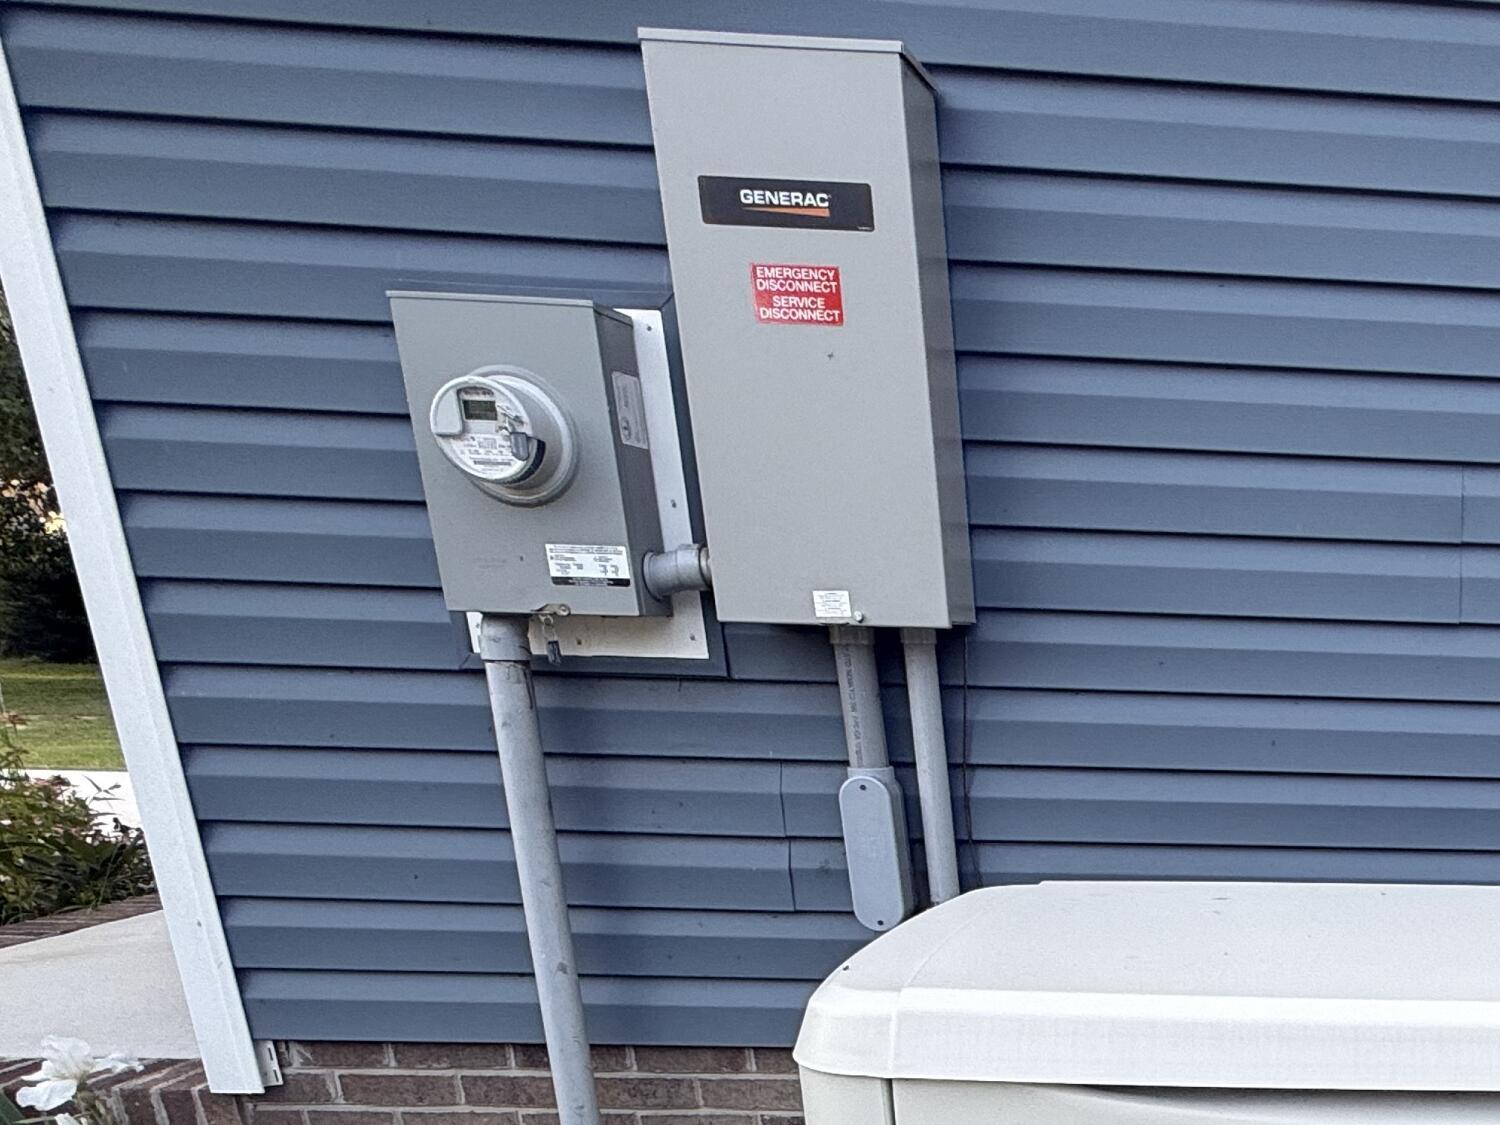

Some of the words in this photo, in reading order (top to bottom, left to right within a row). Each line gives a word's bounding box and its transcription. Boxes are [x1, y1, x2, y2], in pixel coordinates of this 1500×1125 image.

[740, 189, 829, 207] GENERAC
[755, 266, 835, 281] EMERGENCY
[756, 278, 838, 293] DISCONNECT
[772, 295, 826, 309] SERVICE
[760, 307, 841, 322] DISCONNECT
